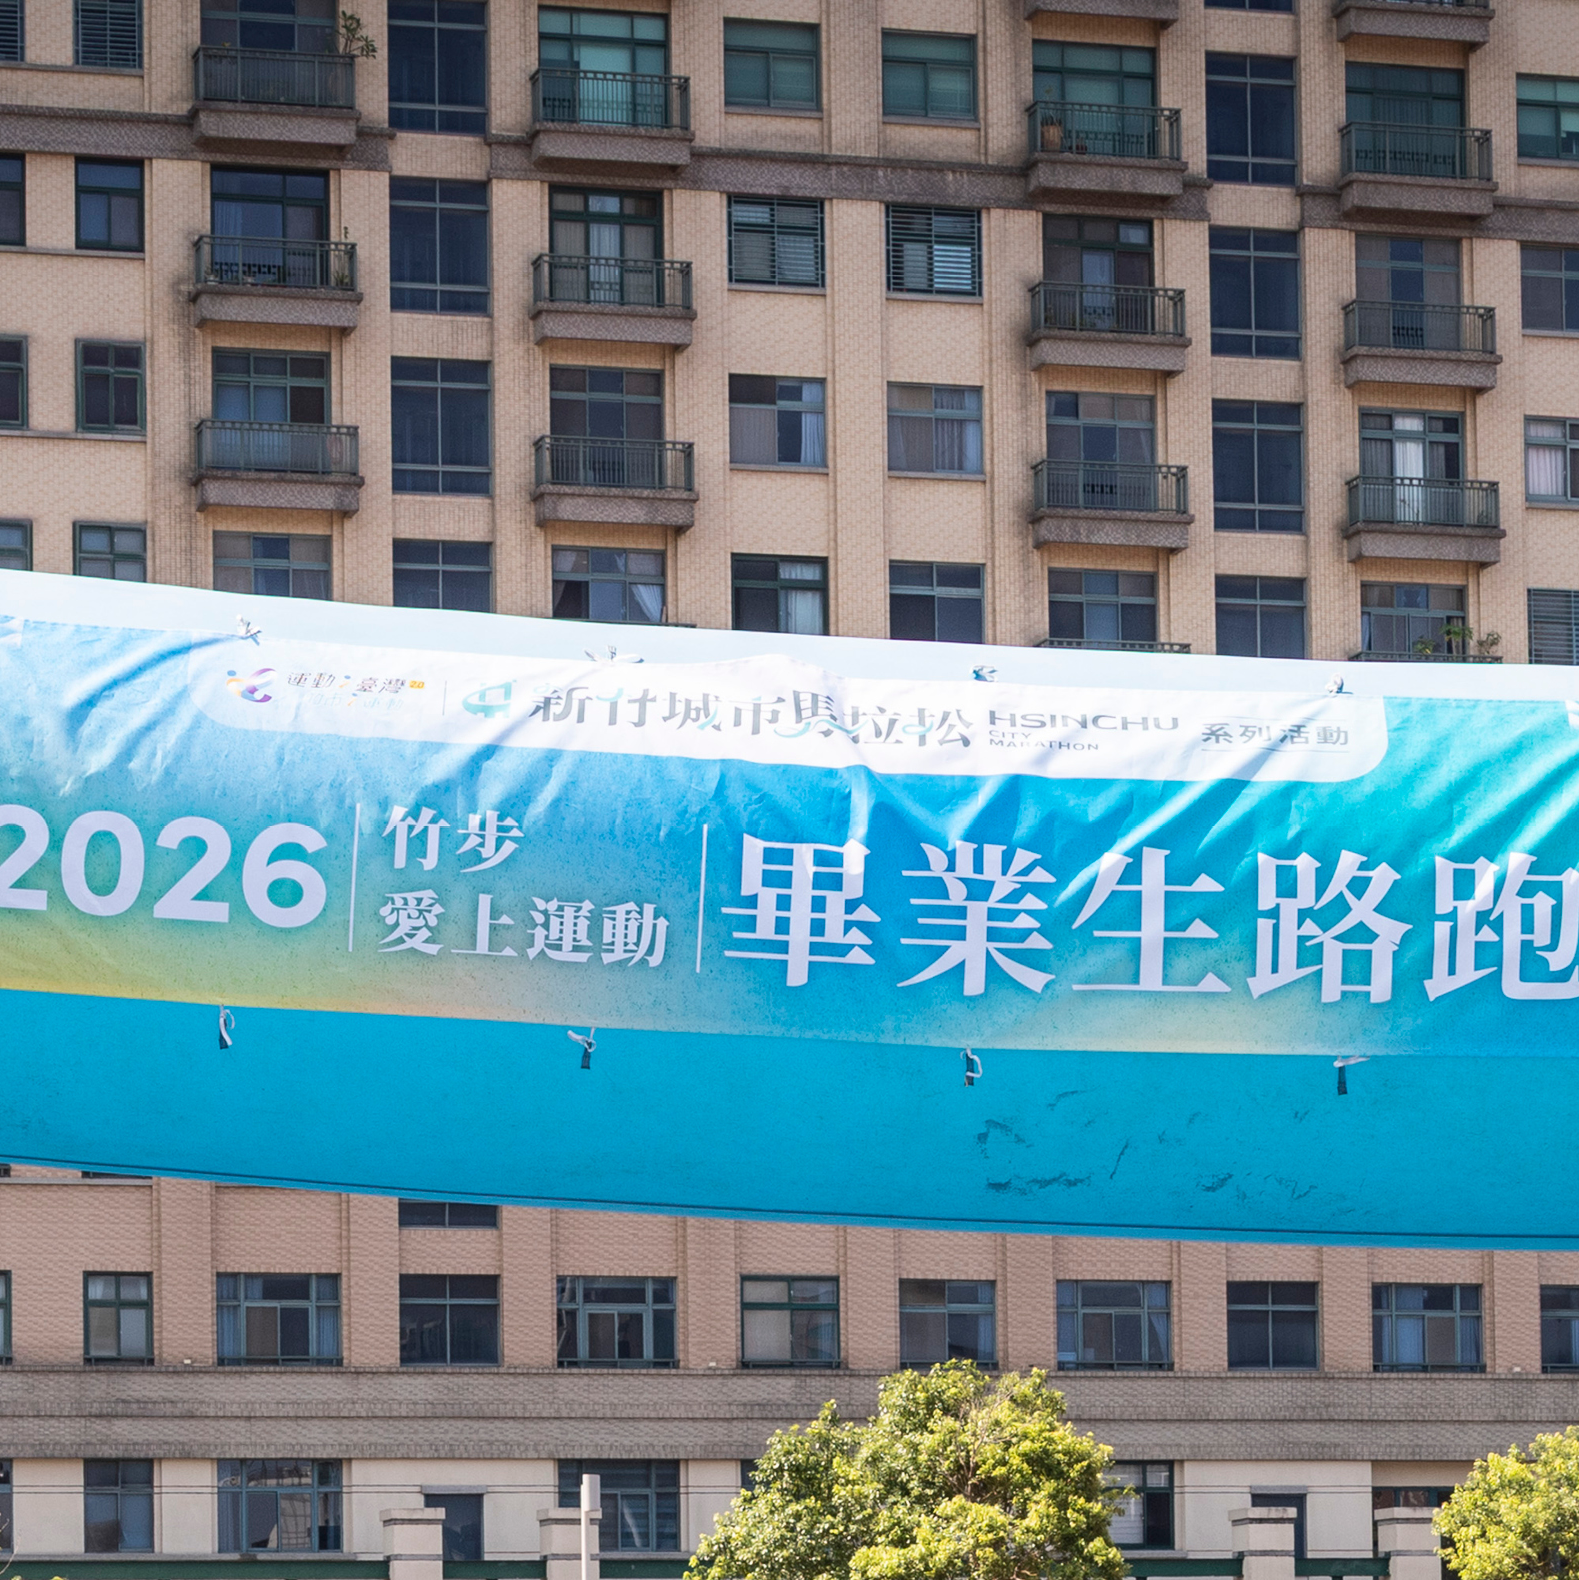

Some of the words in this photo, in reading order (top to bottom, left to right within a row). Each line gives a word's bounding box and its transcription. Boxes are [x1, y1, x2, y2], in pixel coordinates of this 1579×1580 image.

[529, 682, 972, 748] 新竹城市馬拉松
[988, 709, 1180, 731] HSINCHU
[989, 730, 1031, 739] CITY
[989, 738, 1100, 751] MARATHON
[1200, 722, 1350, 746] 系列活動
[382, 803, 524, 872] 竹步
[378, 892, 669, 970] 愛上運動
